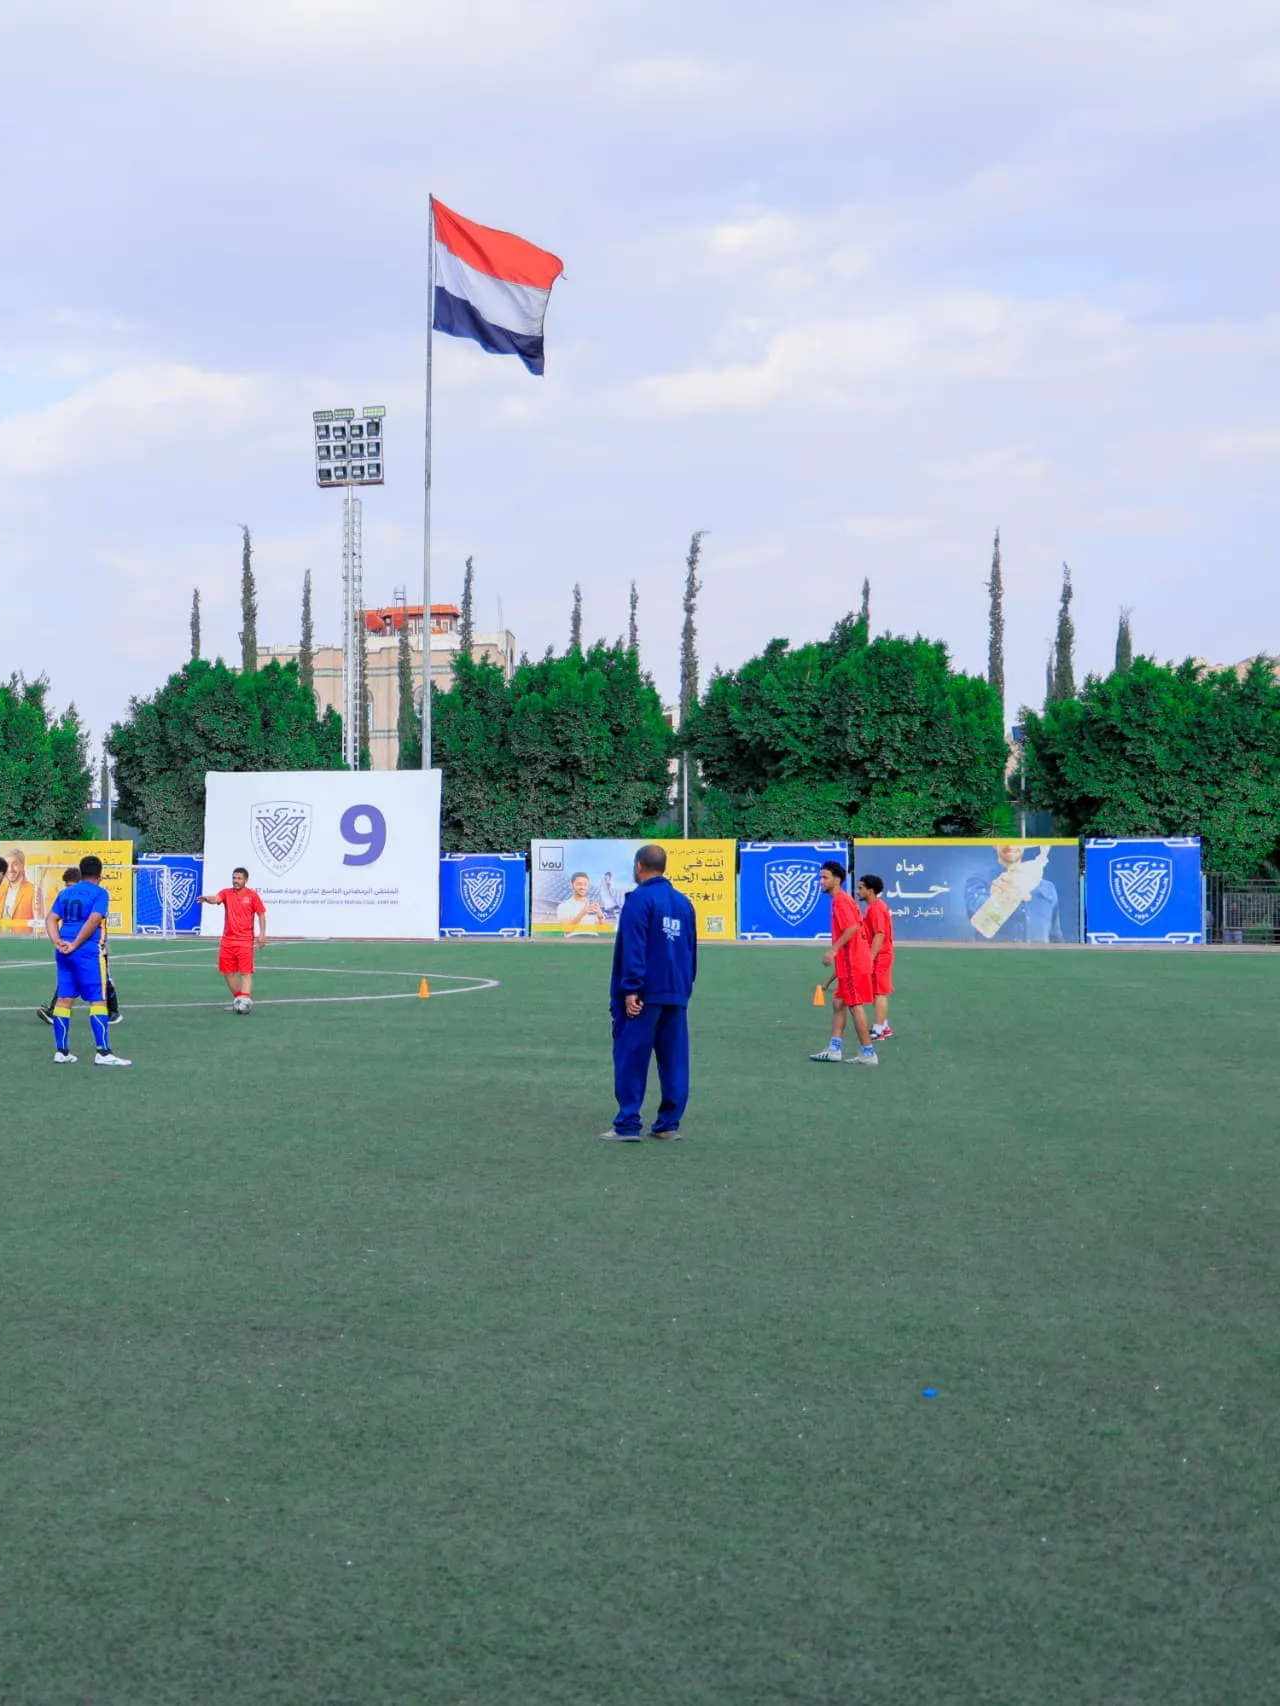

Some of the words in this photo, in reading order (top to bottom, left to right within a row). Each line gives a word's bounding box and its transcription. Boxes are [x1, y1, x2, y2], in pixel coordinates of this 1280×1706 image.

[339, 803, 387, 867] 9
[541, 860, 562, 869] YOU
[683, 857, 703, 872] في
[704, 855, 724, 868] أنت
[895, 858, 924, 876] مياه
[701, 871, 724, 885] قلب
[62, 899, 83, 923] 10
